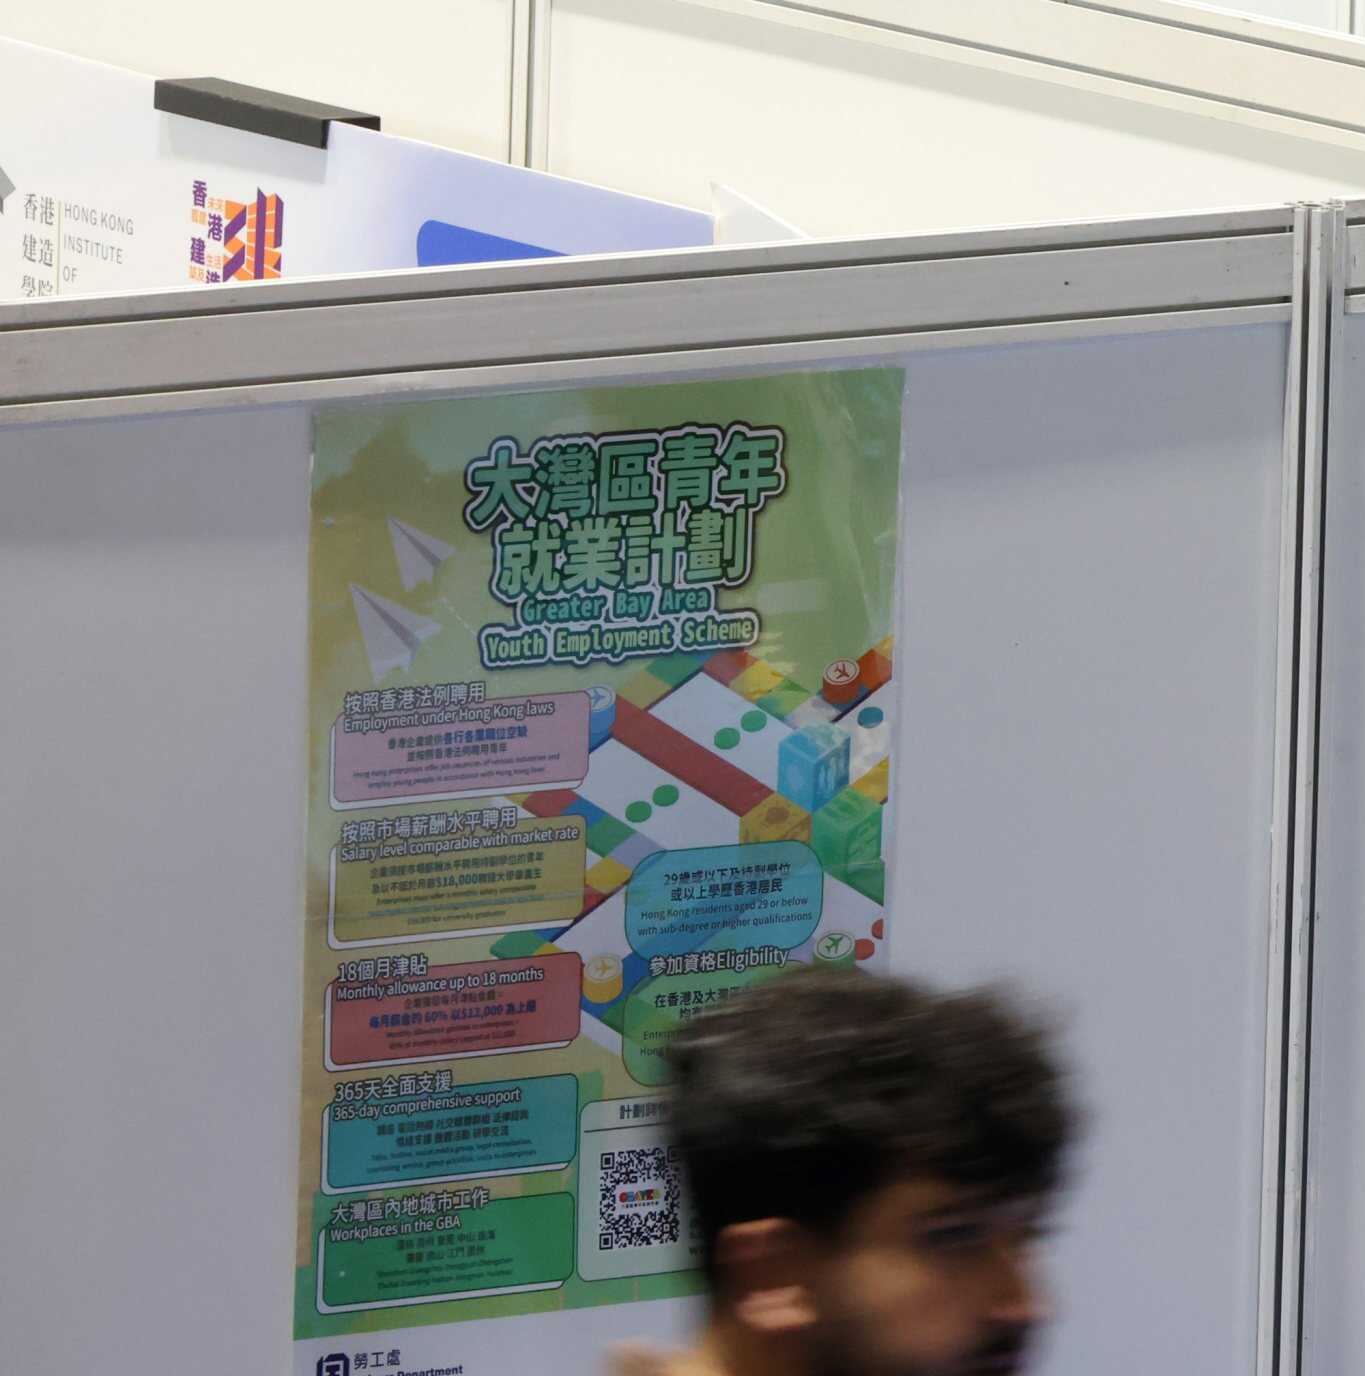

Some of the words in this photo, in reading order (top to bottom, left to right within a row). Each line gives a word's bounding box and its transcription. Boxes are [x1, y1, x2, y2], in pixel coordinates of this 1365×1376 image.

[23, 193, 55, 225] 香港
[64, 201, 97, 226] HONG
[100, 209, 134, 235] KONG
[22, 233, 53, 267] 建造
[64, 234, 123, 265] INSTITUTE
[62, 265, 78, 282] OF
[470, 432, 780, 522] 大灣區青年
[500, 508, 748, 596] 就業計劃
[522, 595, 604, 622] Greater
[614, 593, 652, 619] Bay
[662, 588, 710, 612] Area
[488, 634, 543, 658] Youth
[558, 623, 673, 658] Employment
[683, 616, 753, 643] Scheme
[346, 685, 484, 714] 按照香港法例聘用
[344, 714, 419, 734] Employment
[422, 712, 457, 724] under
[461, 709, 489, 724] Hong
[494, 706, 525, 721] Kong
[528, 703, 554, 715] laws
[343, 809, 518, 841] 按照市場薪酬水平聘用
[342, 847, 376, 864] Salary
[380, 843, 408, 857] level
[411, 837, 480, 858] comparable
[483, 835, 508, 847] with
[511, 831, 553, 845] market
[557, 828, 578, 841] rate
[338, 956, 428, 980] 18個月津貼
[650, 947, 789, 975] 參加資格Eligibility
[337, 986, 384, 1002] Monthly
[388, 979, 447, 994] allowance
[450, 979, 464, 991] up
[468, 975, 480, 986] to
[483, 973, 497, 985] 18
[501, 969, 544, 983] months
[335, 1073, 452, 1102] 365天全面支援
[335, 1103, 380, 1120] 365-day
[383, 1095, 474, 1115] comprehensive
[476, 1090, 521, 1105] support
[332, 1190, 489, 1222] 大灣區內地城市工作
[332, 1224, 398, 1242] Workplaces
[402, 1222, 412, 1234] in
[415, 1220, 433, 1232] the
[436, 1218, 460, 1230] GBA
[354, 1350, 401, 1369] 勞工處
